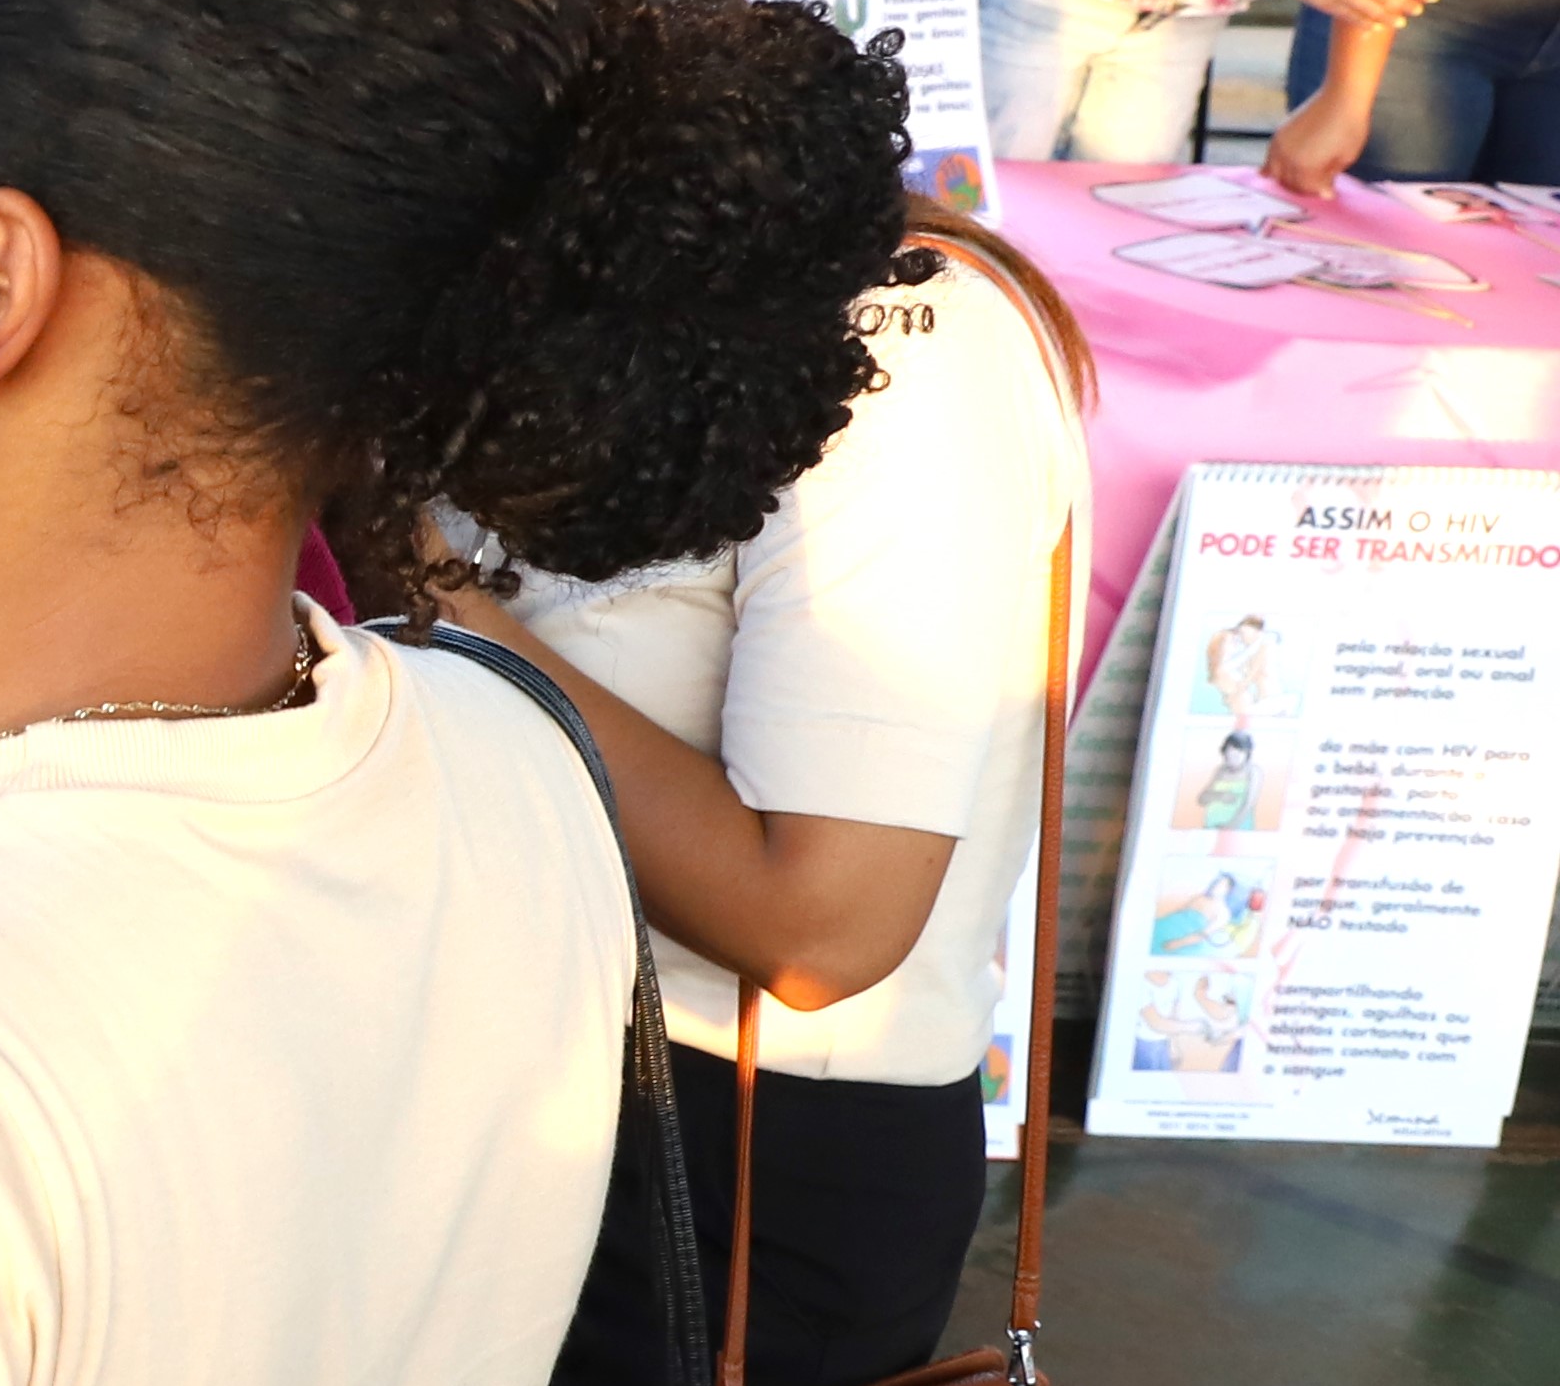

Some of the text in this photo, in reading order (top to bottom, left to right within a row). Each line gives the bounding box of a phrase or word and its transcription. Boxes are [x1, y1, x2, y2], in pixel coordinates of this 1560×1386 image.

[1296, 506, 1500, 533] ASSIM O HIV
[1199, 533, 1560, 569] PODE SER TRANSMITIDO
